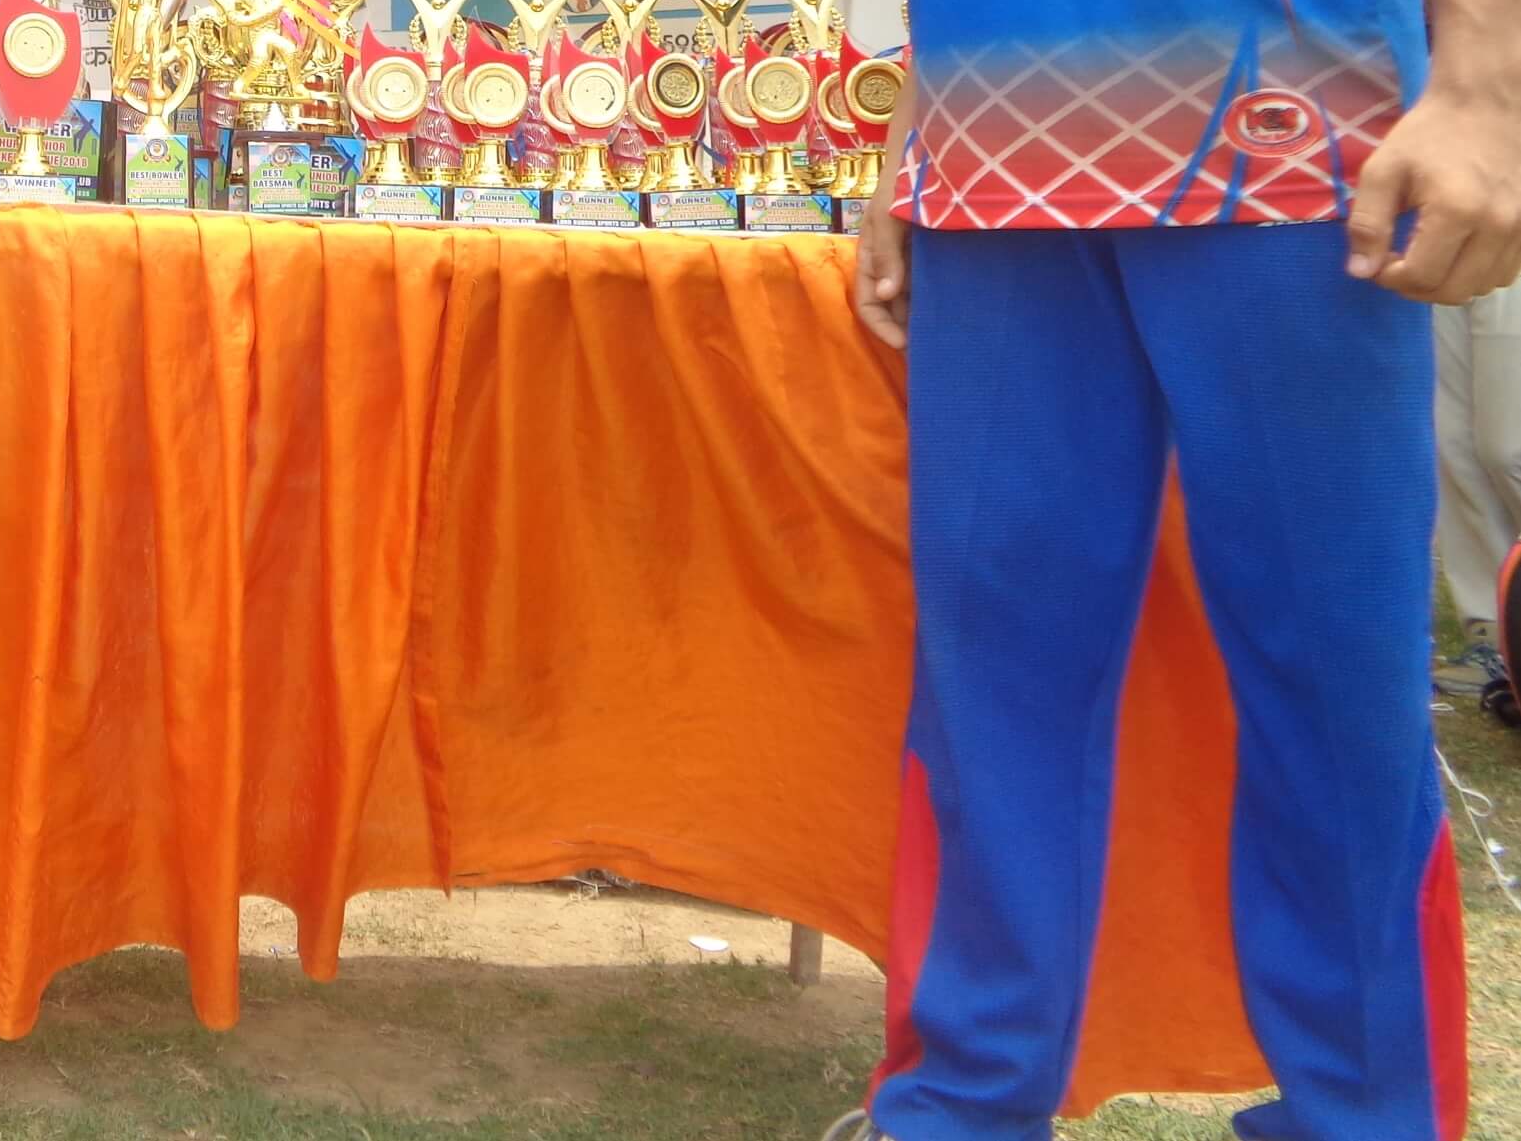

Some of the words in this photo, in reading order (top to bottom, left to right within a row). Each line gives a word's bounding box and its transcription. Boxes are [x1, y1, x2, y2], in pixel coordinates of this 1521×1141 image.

[262, 169, 283, 177] BEST
[14, 178, 57, 188] WINNER
[380, 191, 416, 199] RUNNER
[479, 194, 515, 202] RUNNER
[578, 196, 614, 204] RUNNER
